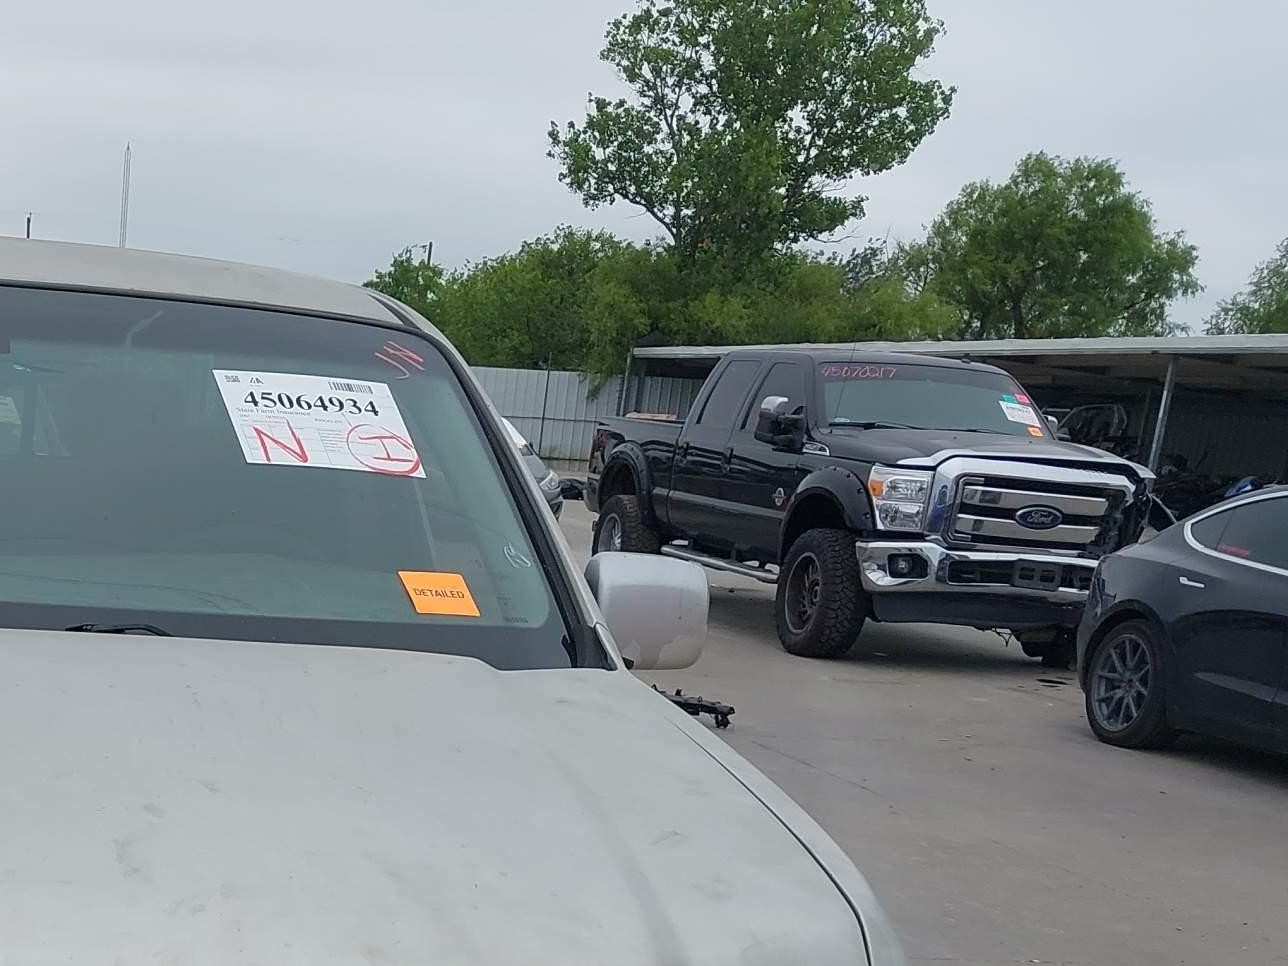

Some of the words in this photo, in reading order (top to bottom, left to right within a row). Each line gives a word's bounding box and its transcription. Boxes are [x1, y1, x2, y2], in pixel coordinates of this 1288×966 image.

[244, 391, 380, 417] 45064934
[252, 419, 309, 463] N
[1027, 510, 1054, 523] Ford
[413, 587, 465, 600] DETAILED
